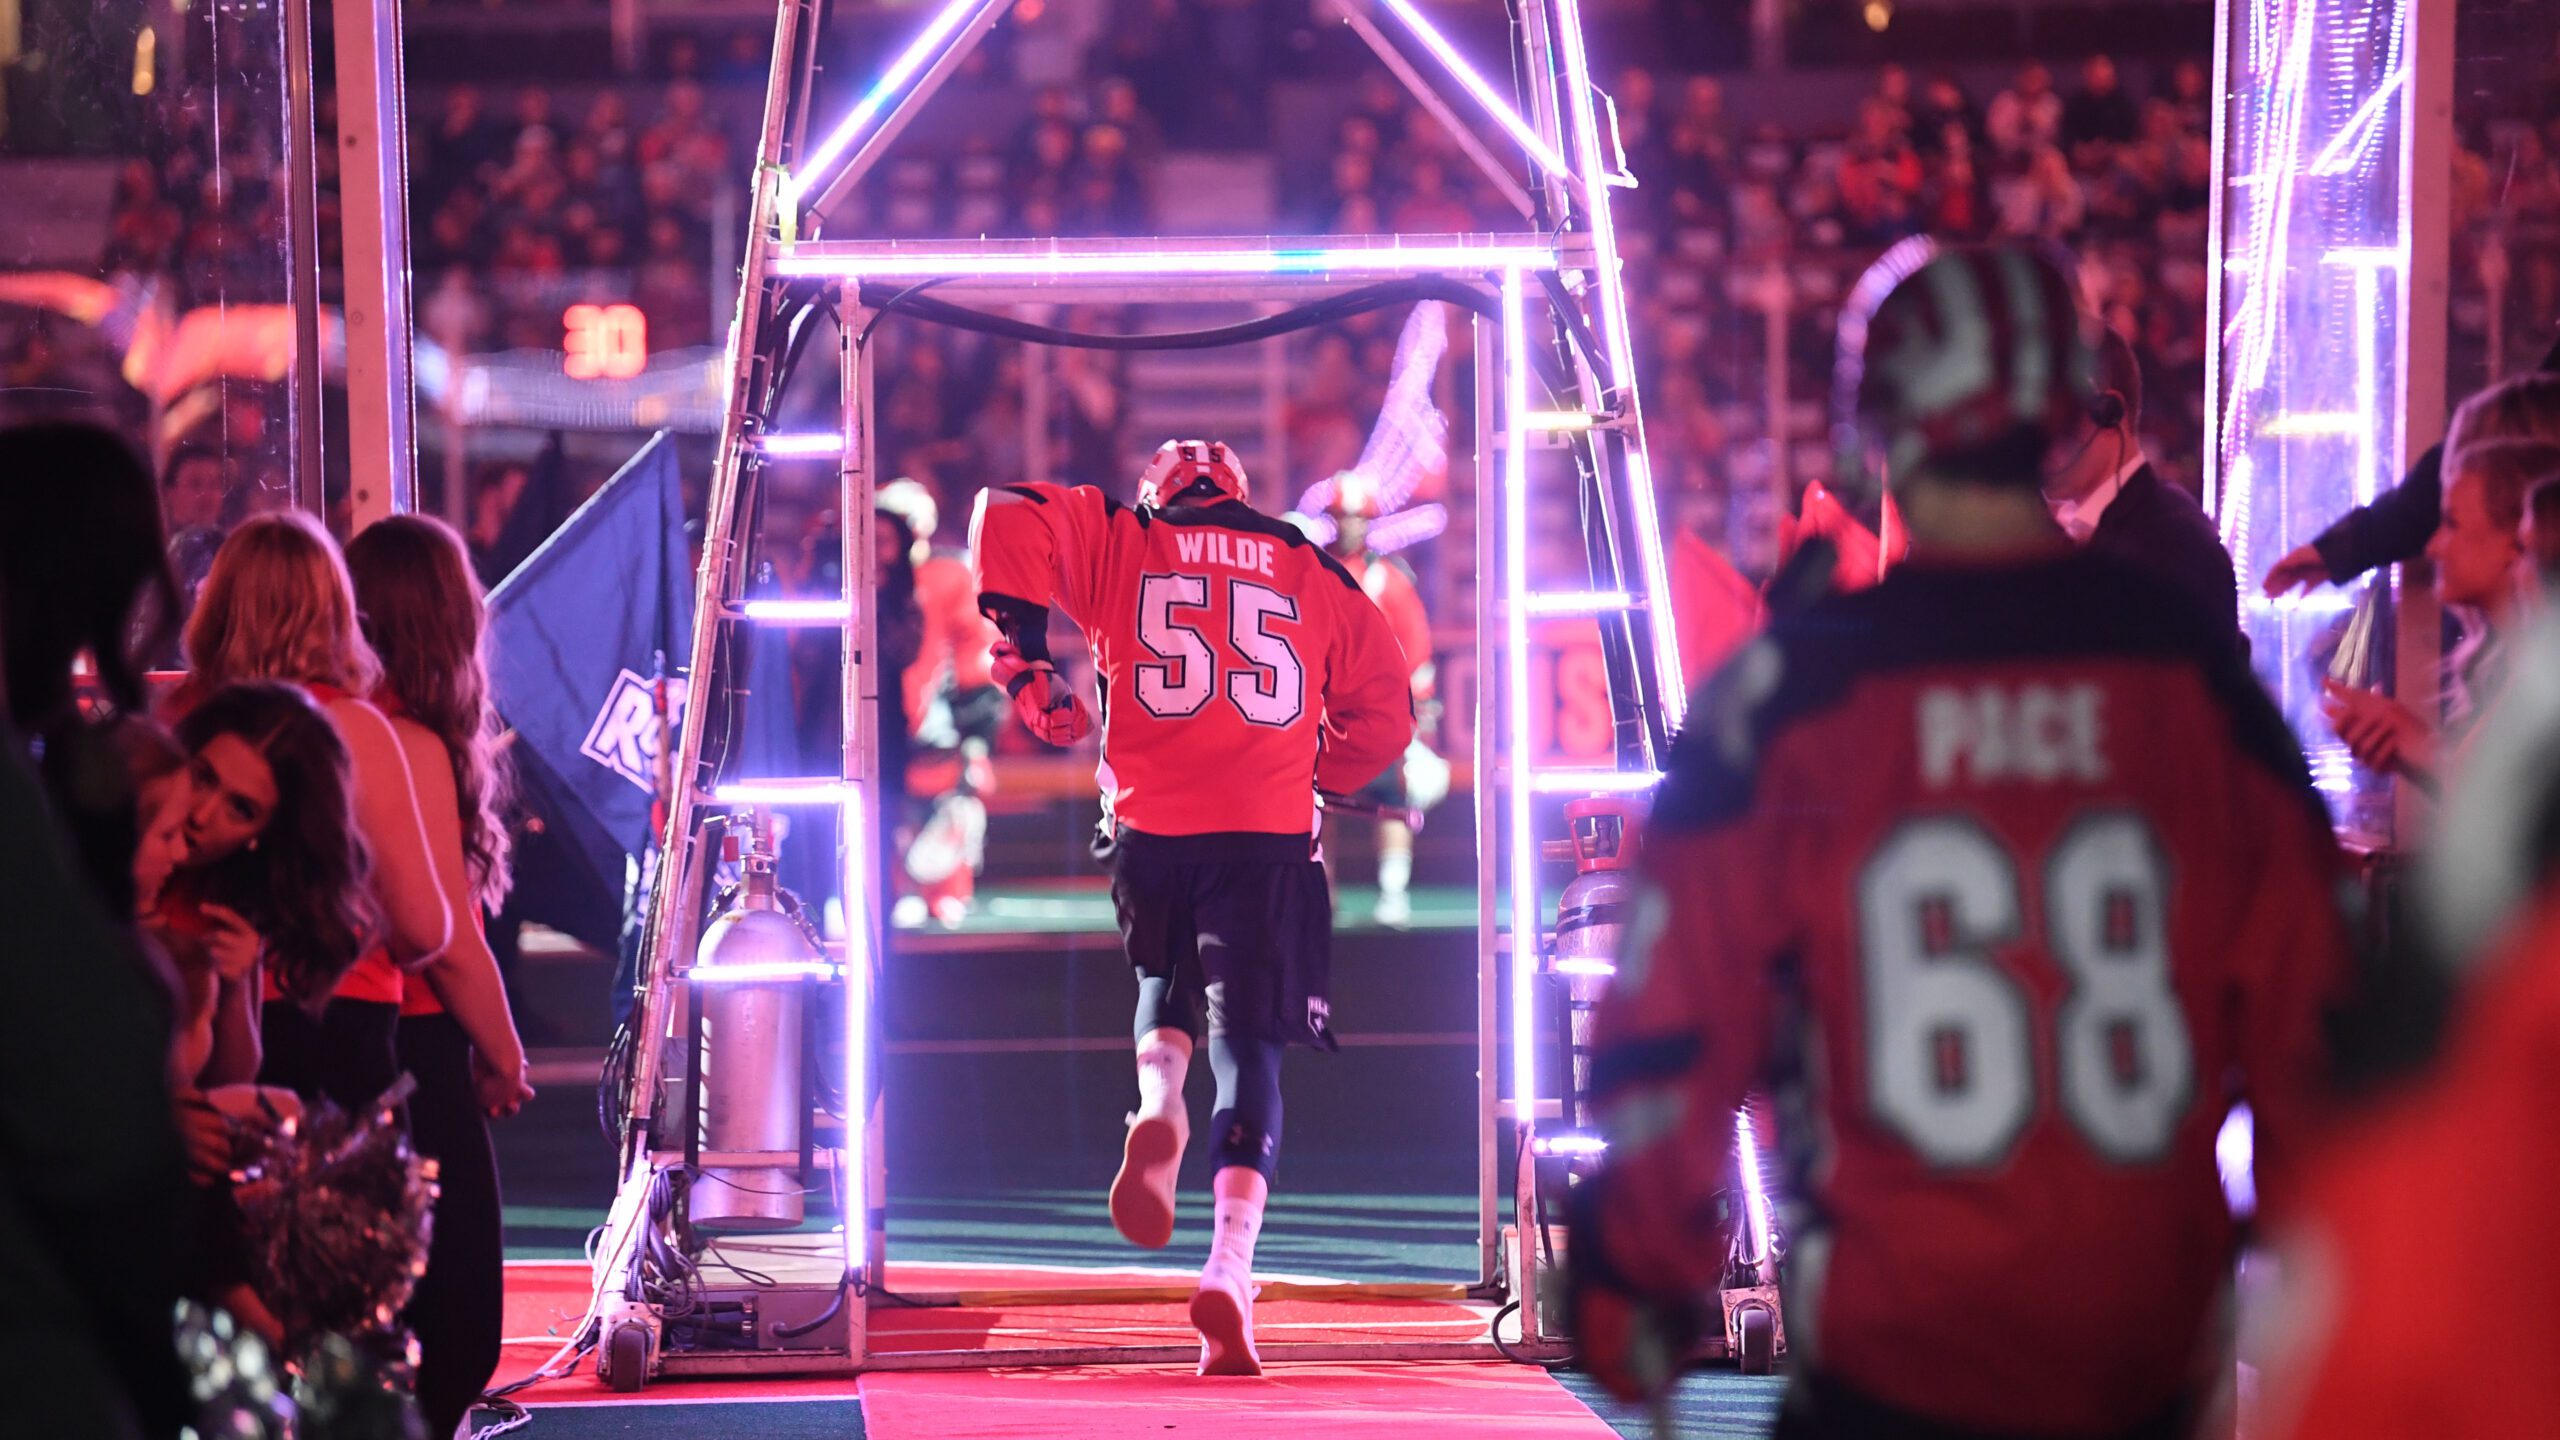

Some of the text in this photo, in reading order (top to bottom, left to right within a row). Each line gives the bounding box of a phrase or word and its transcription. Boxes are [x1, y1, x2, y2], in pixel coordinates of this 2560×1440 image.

[563, 304, 647, 379] 30
[1175, 532, 1274, 578] WILDE
[1135, 571, 1305, 728] 55
[1918, 683, 2110, 786] PACE
[1860, 808, 2197, 1170] 68
